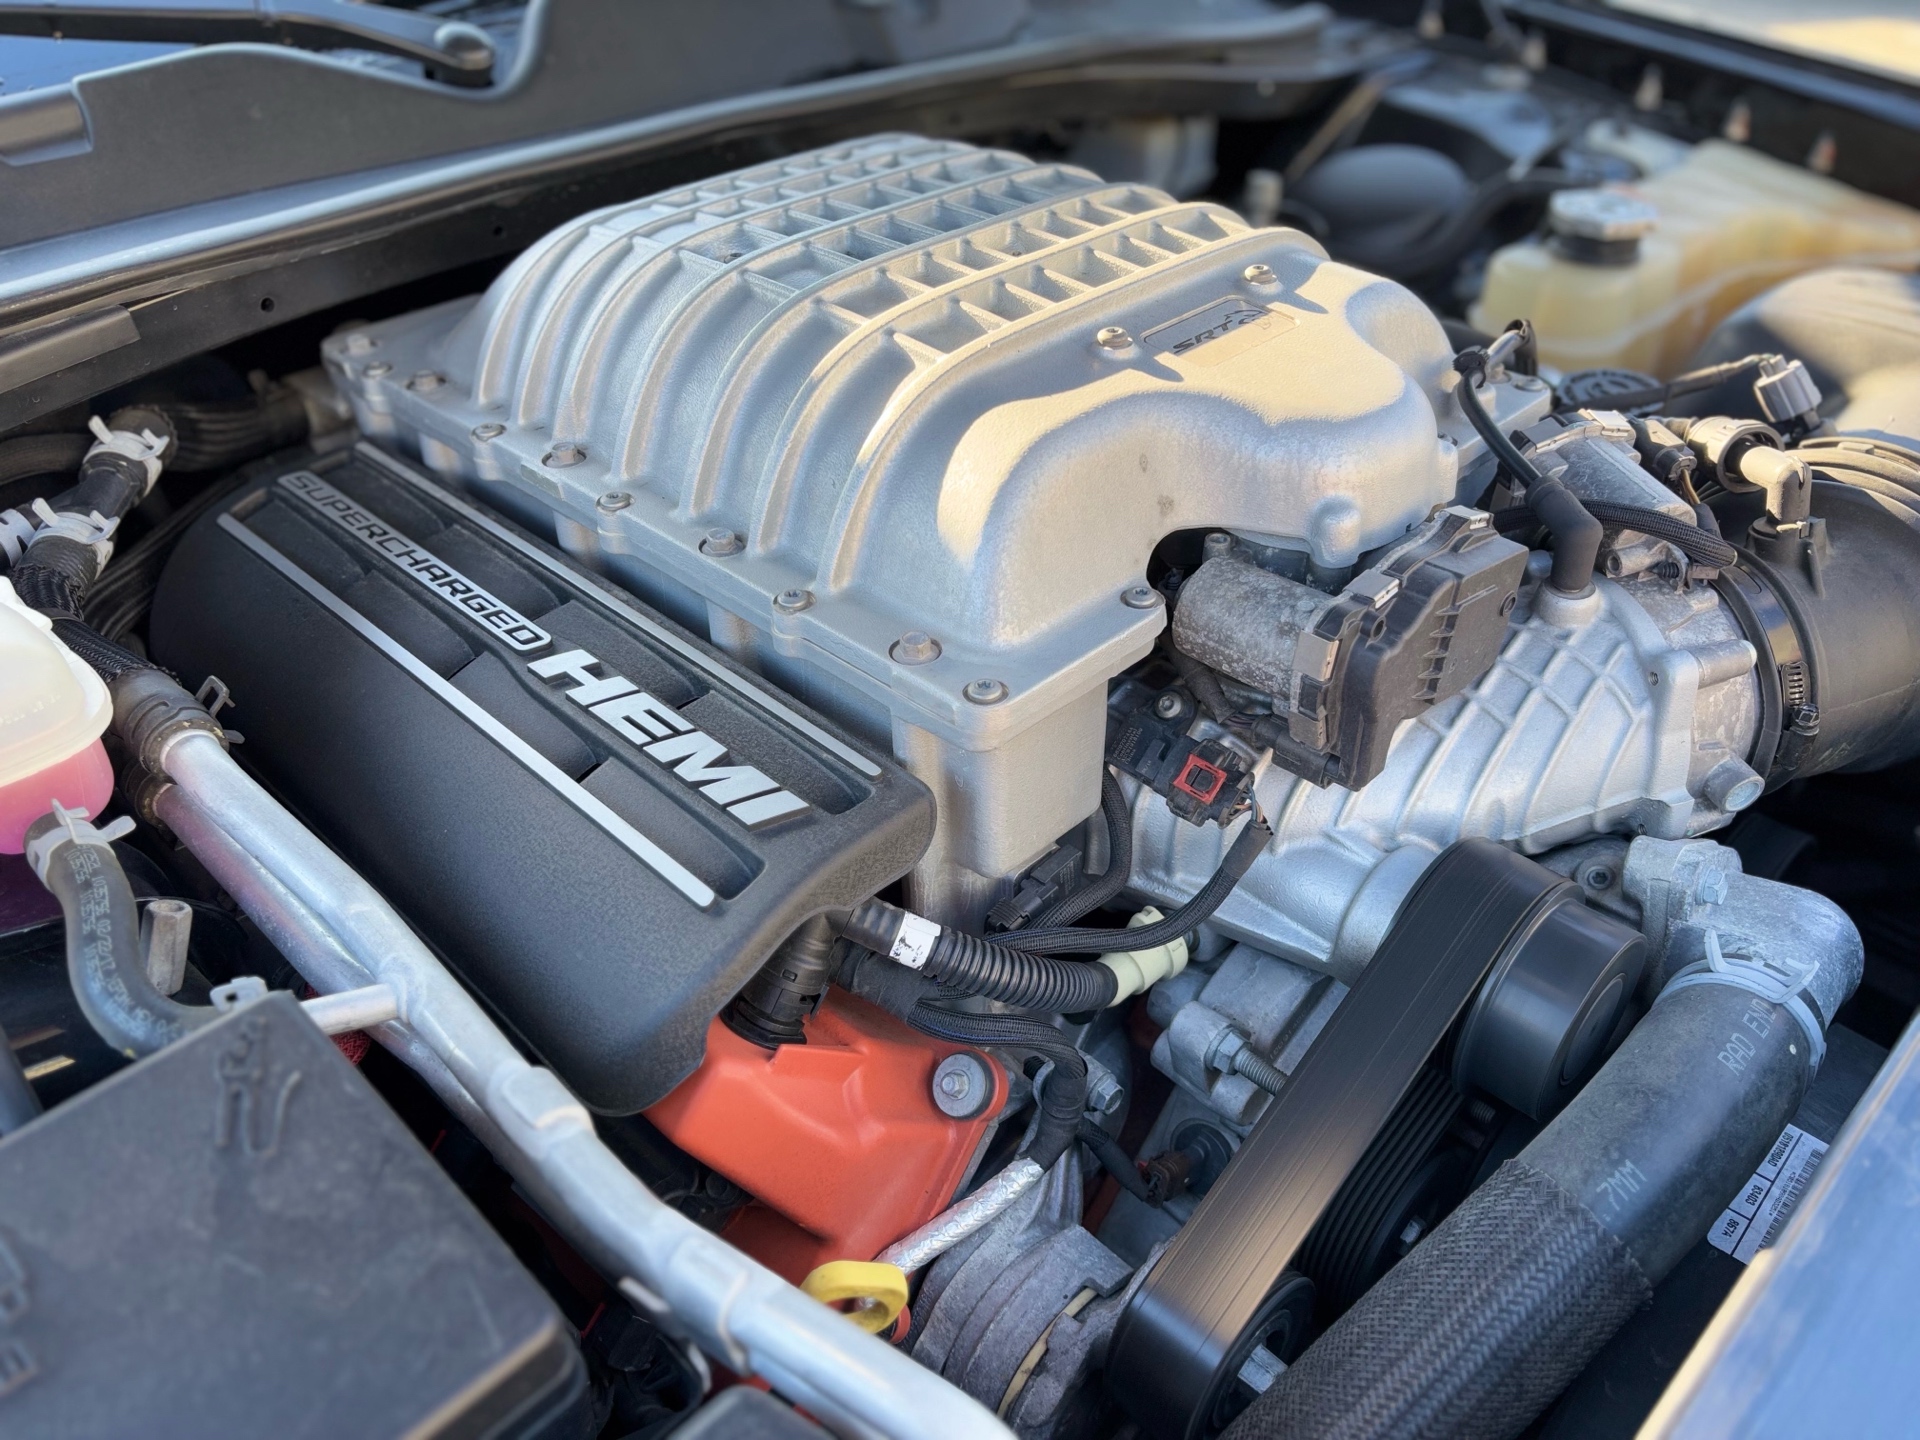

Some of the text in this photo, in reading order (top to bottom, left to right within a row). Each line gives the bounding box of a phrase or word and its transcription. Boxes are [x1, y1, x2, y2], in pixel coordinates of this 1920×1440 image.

[1173, 320, 1233, 354] SRT
[284, 473, 542, 647] SUPERCHARGED
[527, 649, 812, 831] HEMI
[97, 919, 116, 970] 02/22/17
[1717, 999, 1777, 1076] RAD END
[1596, 1159, 1647, 1211] 7MM
[1744, 1183, 1763, 1206] 83403
[1720, 1217, 1739, 1238] 867A
